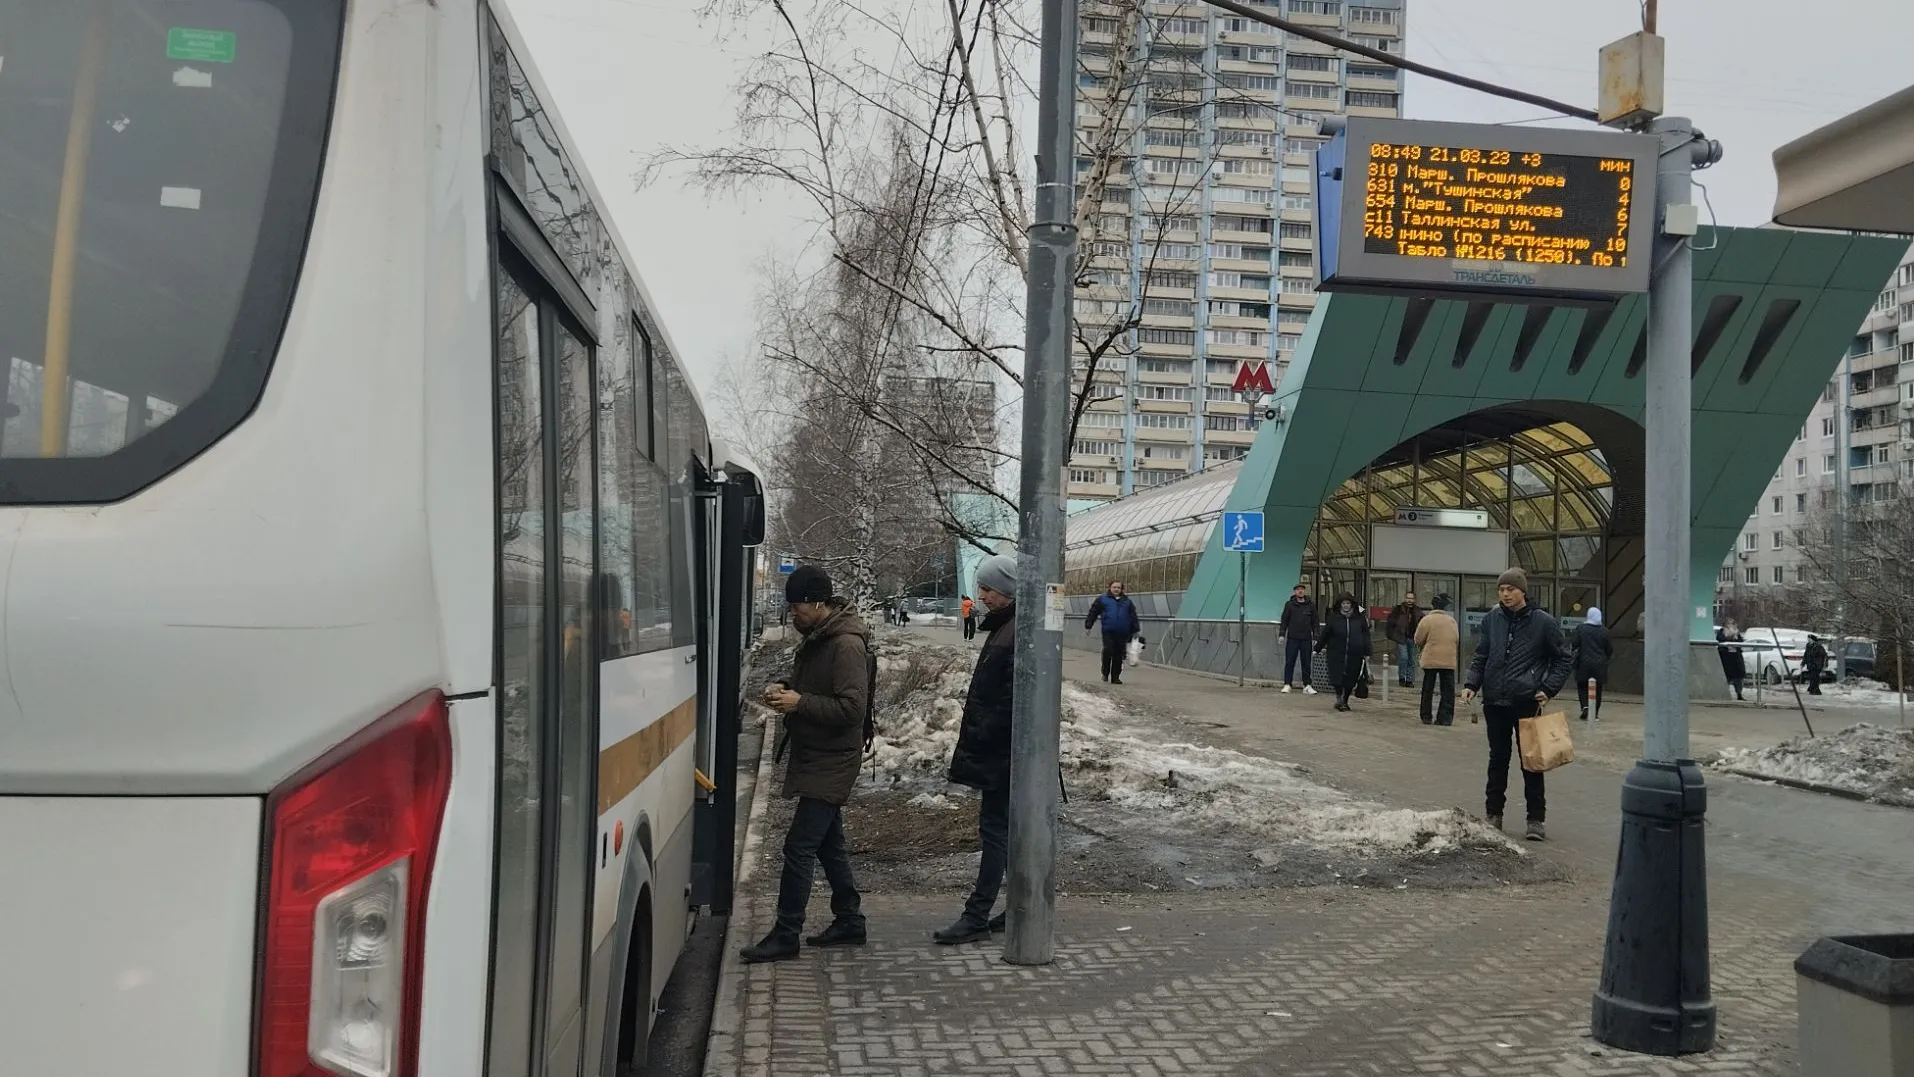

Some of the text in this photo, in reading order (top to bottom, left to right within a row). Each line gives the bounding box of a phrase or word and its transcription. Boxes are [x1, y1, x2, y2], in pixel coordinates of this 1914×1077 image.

[1371, 144, 1421, 160] 08:49
[1430, 147, 1510, 165] 21.03.23
[1521, 153, 1541, 167] +3
[1368, 162, 1630, 190] 310 Марш. Прошлякова 0
[1366, 178, 1395, 193] 631
[1618, 192, 1629, 205] 4
[1366, 194, 1628, 222] 654 Марш. Прошлякова 6
[1401, 211, 1500, 230] Таллинская
[1509, 220, 1535, 232] ул.
[1616, 223, 1627, 237] 7
[1365, 224, 1394, 239] 743
[1454, 229, 1482, 244] (по
[1606, 237, 1626, 252] 10
[1398, 241, 1447, 257] Табло
[1515, 247, 1581, 265] (1250).
[1591, 251, 1613, 267] По
[1454, 271, 1536, 285] ТРАНСДЕТАЛЬ
